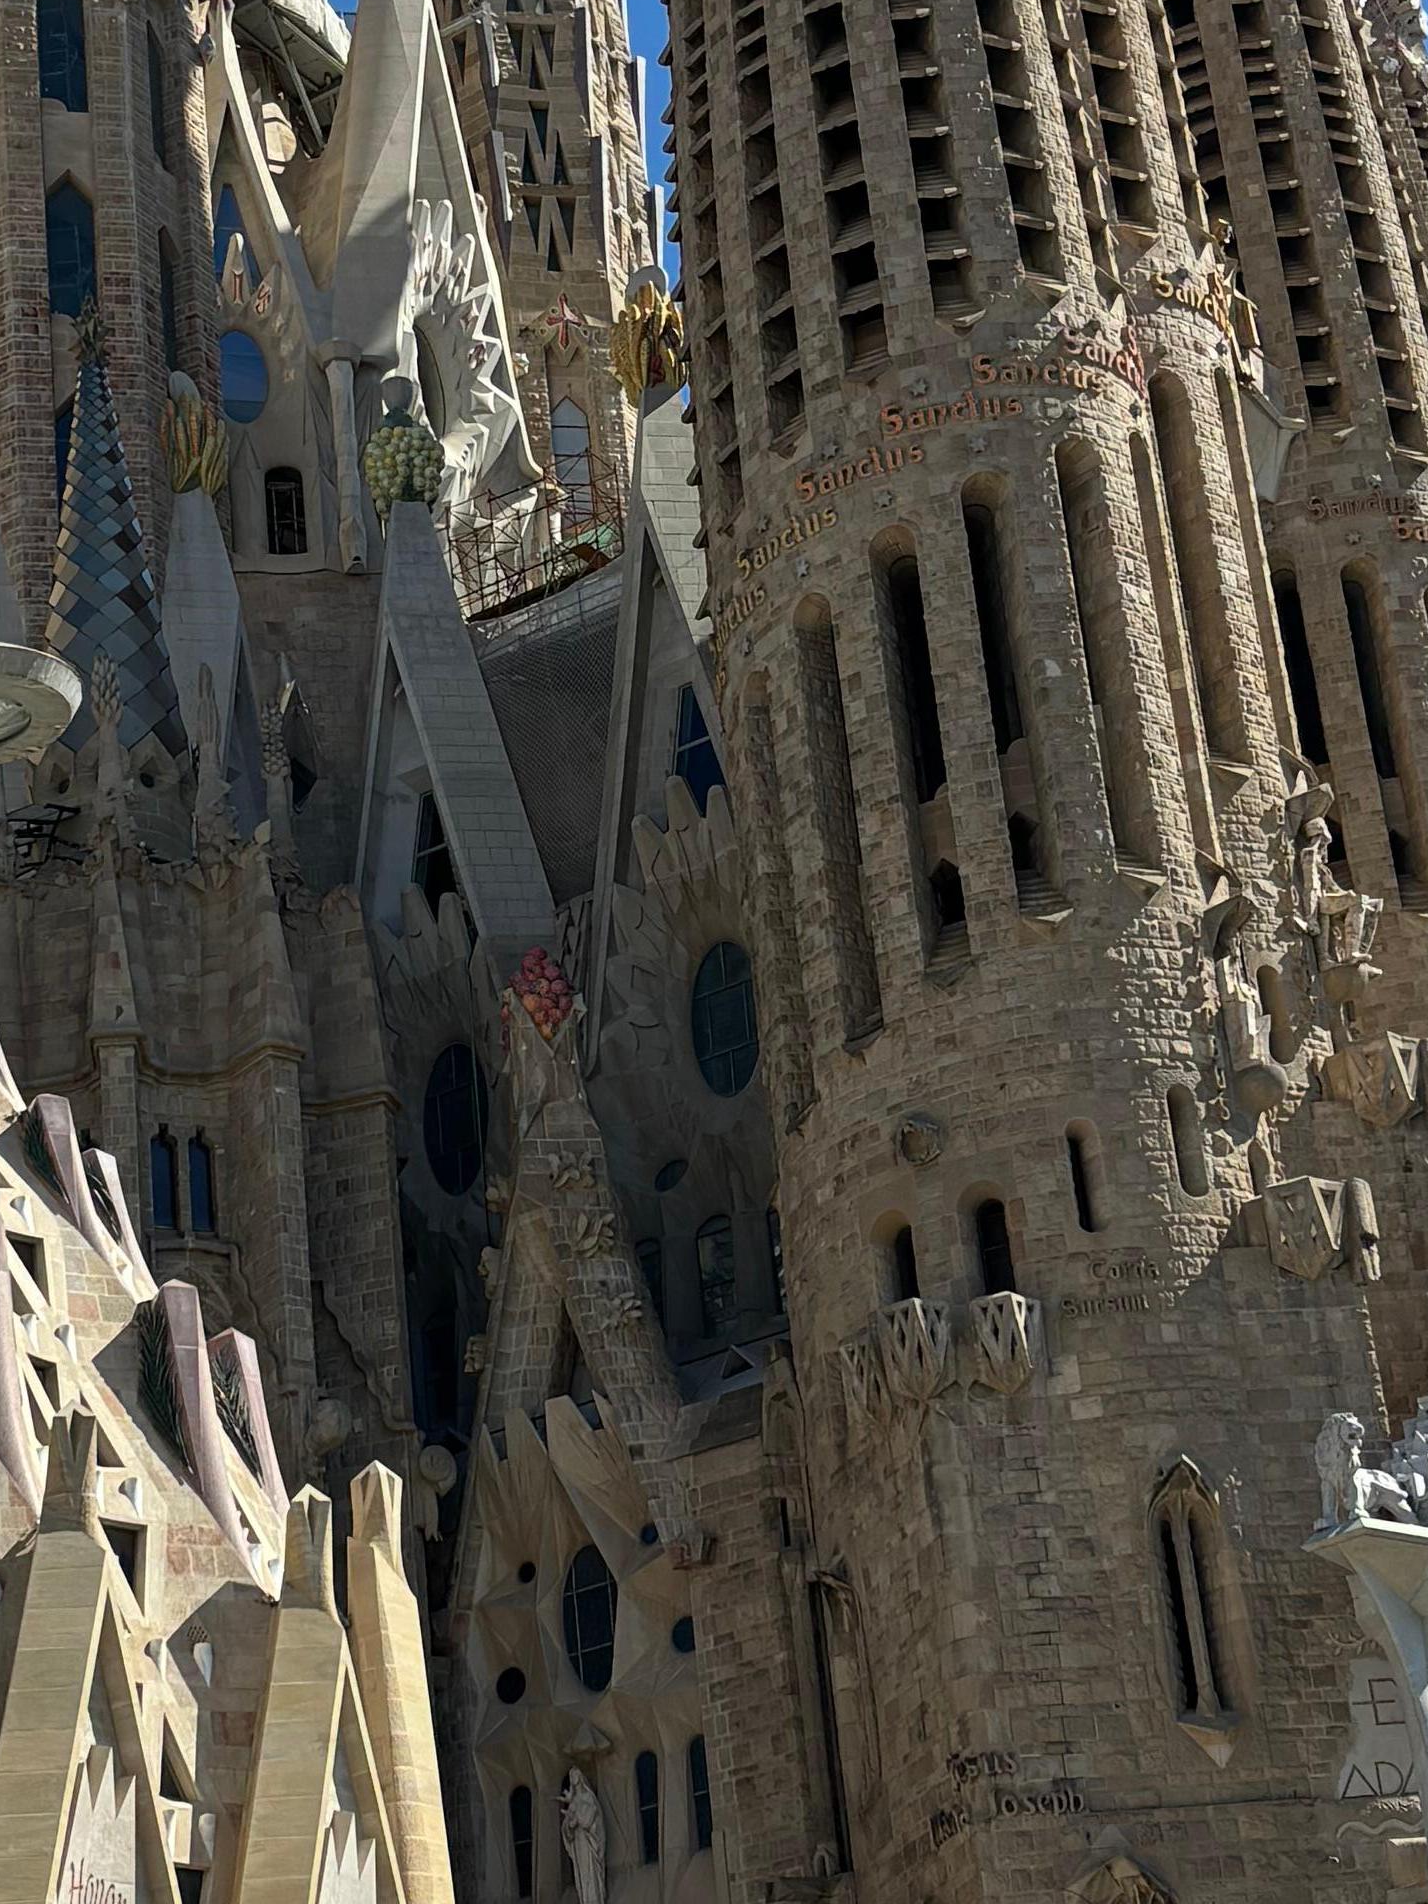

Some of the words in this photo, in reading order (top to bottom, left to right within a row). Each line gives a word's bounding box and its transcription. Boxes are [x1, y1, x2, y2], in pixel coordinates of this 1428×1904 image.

[972, 353, 1109, 393] Sanctus
[879, 390, 1023, 437] Sanctus
[794, 443, 926, 504] Sanctus
[734, 505, 839, 582] Sanctus
[987, 1783, 1086, 1818] Joseph
